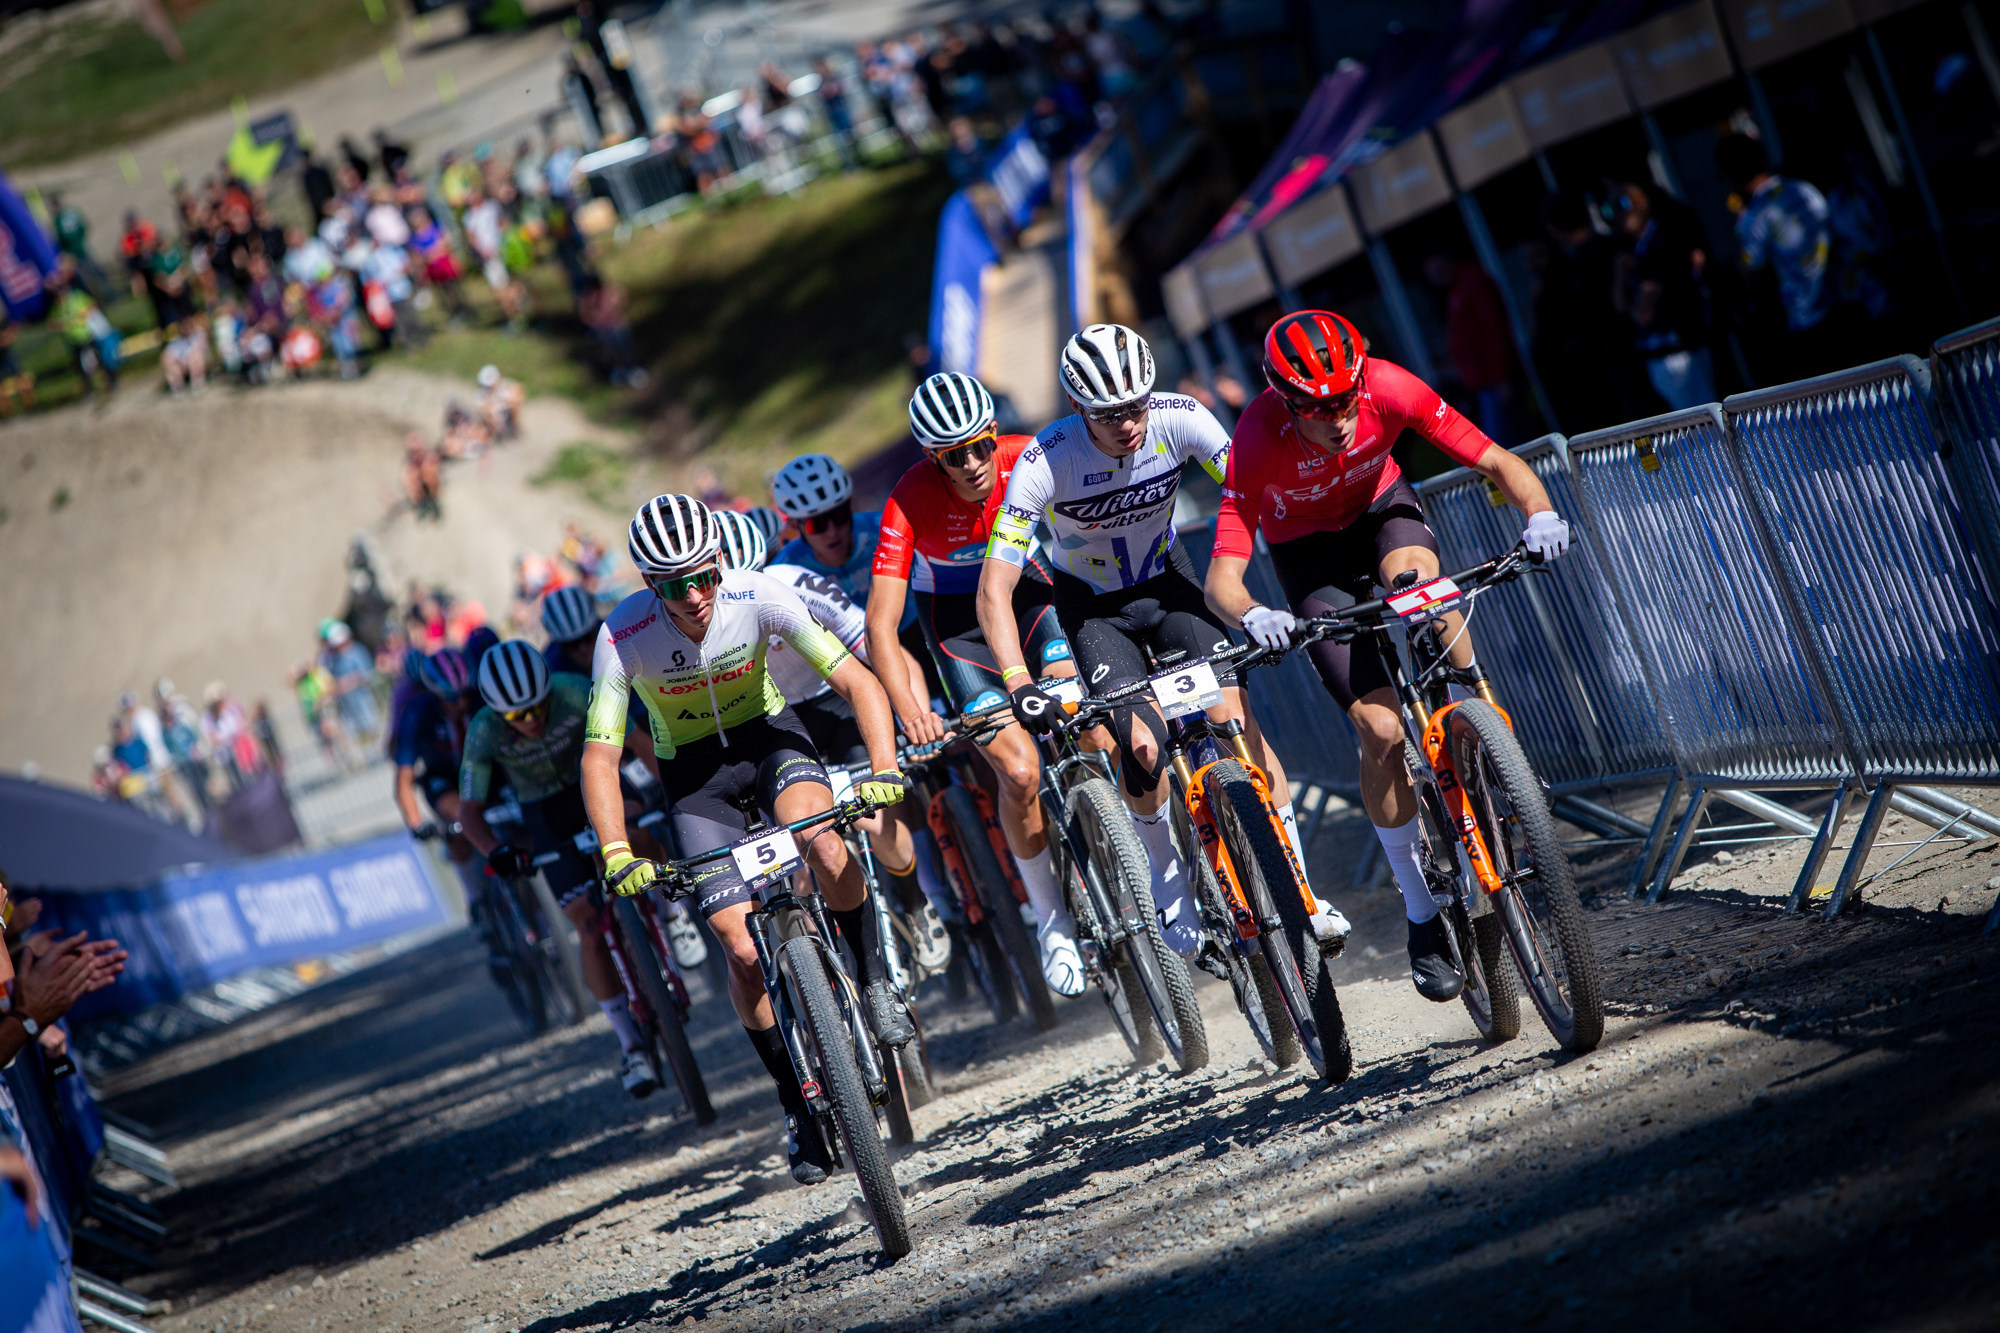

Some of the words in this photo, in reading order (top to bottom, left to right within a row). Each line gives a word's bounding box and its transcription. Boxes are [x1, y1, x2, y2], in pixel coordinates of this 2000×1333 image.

[1064, 364, 1087, 392] MET
[1288, 376, 1316, 395] CUBE
[1007, 504, 1034, 521] FOX
[793, 572, 852, 612] KTM
[1414, 590, 1432, 602] 1
[607, 613, 657, 646] Lexware
[659, 659, 755, 695] Lexware
[1157, 658, 1199, 677] WHOOP
[666, 674, 698, 684] JOBRAD
[1036, 678, 1065, 691] HOOP
[1174, 674, 1196, 694] 3
[700, 694, 746, 719] DAVOS
[739, 826, 779, 844] WHOOP
[756, 842, 776, 865] 5
